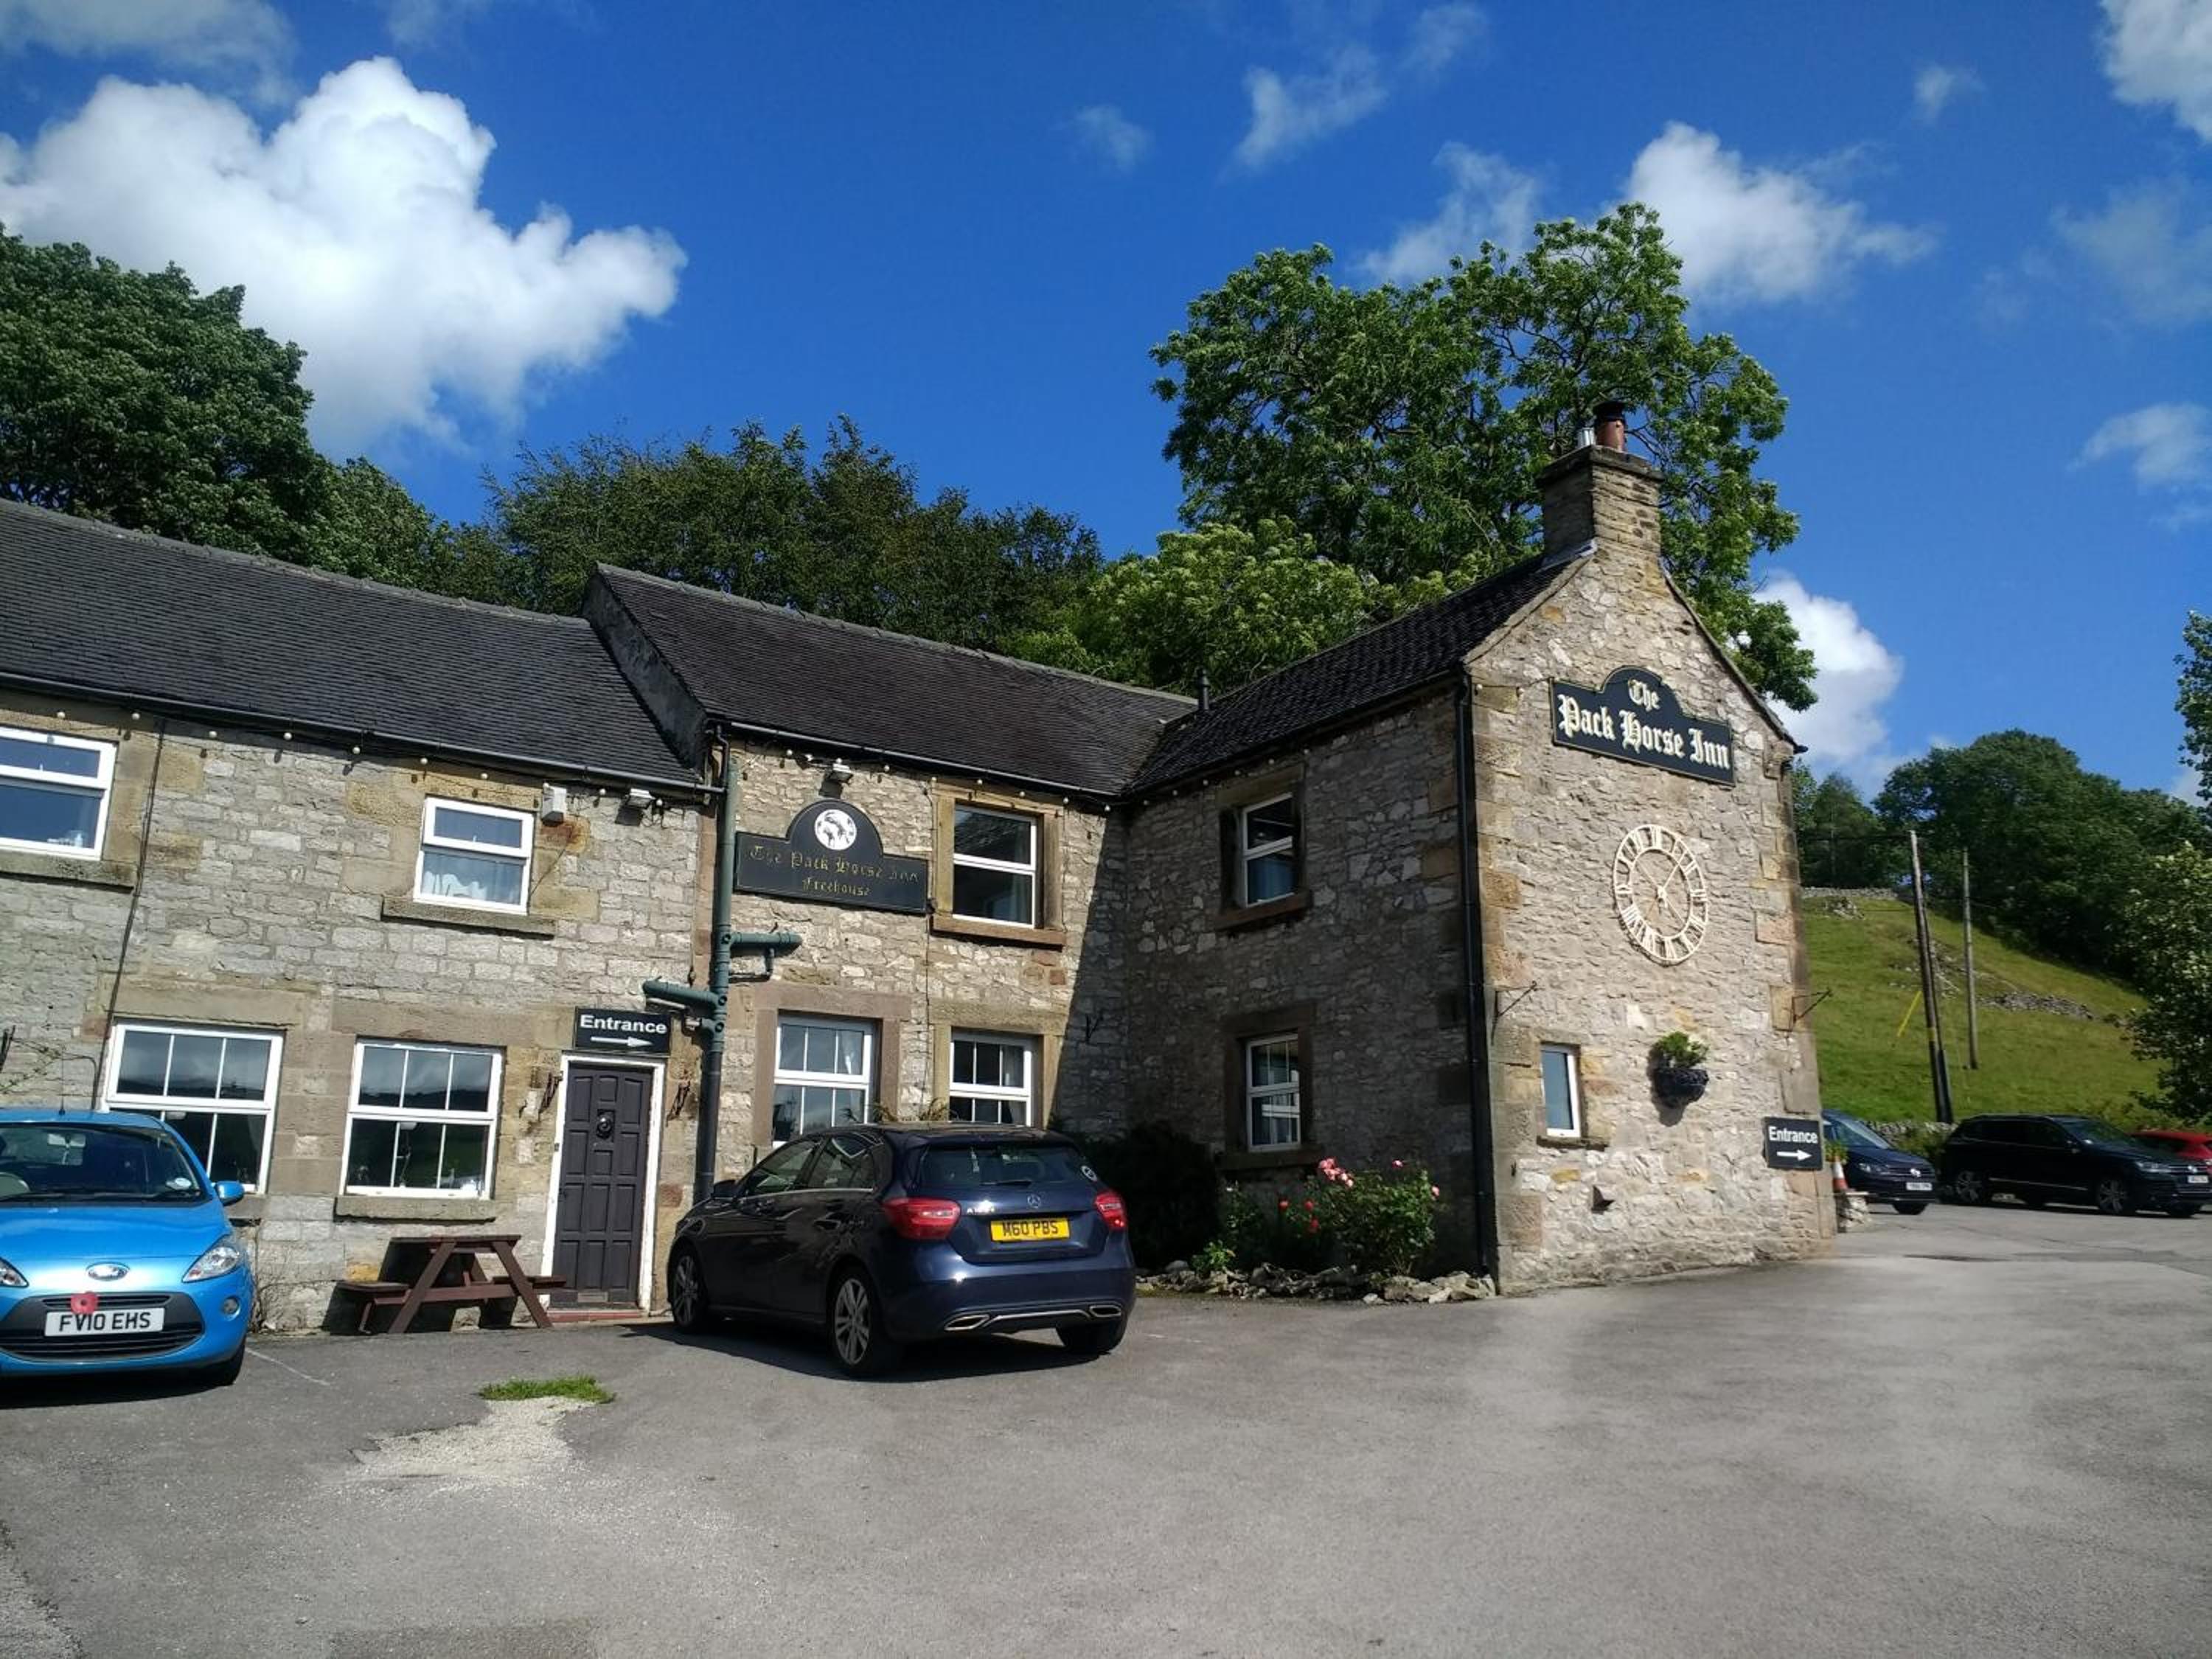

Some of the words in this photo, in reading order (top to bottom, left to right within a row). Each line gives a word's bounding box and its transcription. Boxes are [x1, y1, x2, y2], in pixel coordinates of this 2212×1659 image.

[1627, 678, 1660, 712] The
[1557, 694, 1616, 741] Pack
[1618, 709, 1686, 759] Horse
[1688, 728, 1731, 771] Inn
[790, 851, 829, 872] Pack
[580, 1014, 667, 1034] Entrance
[1768, 1126, 1818, 1144] Entrance
[1033, 1220, 1059, 1236] PBS
[111, 1311, 151, 1330] EHS
